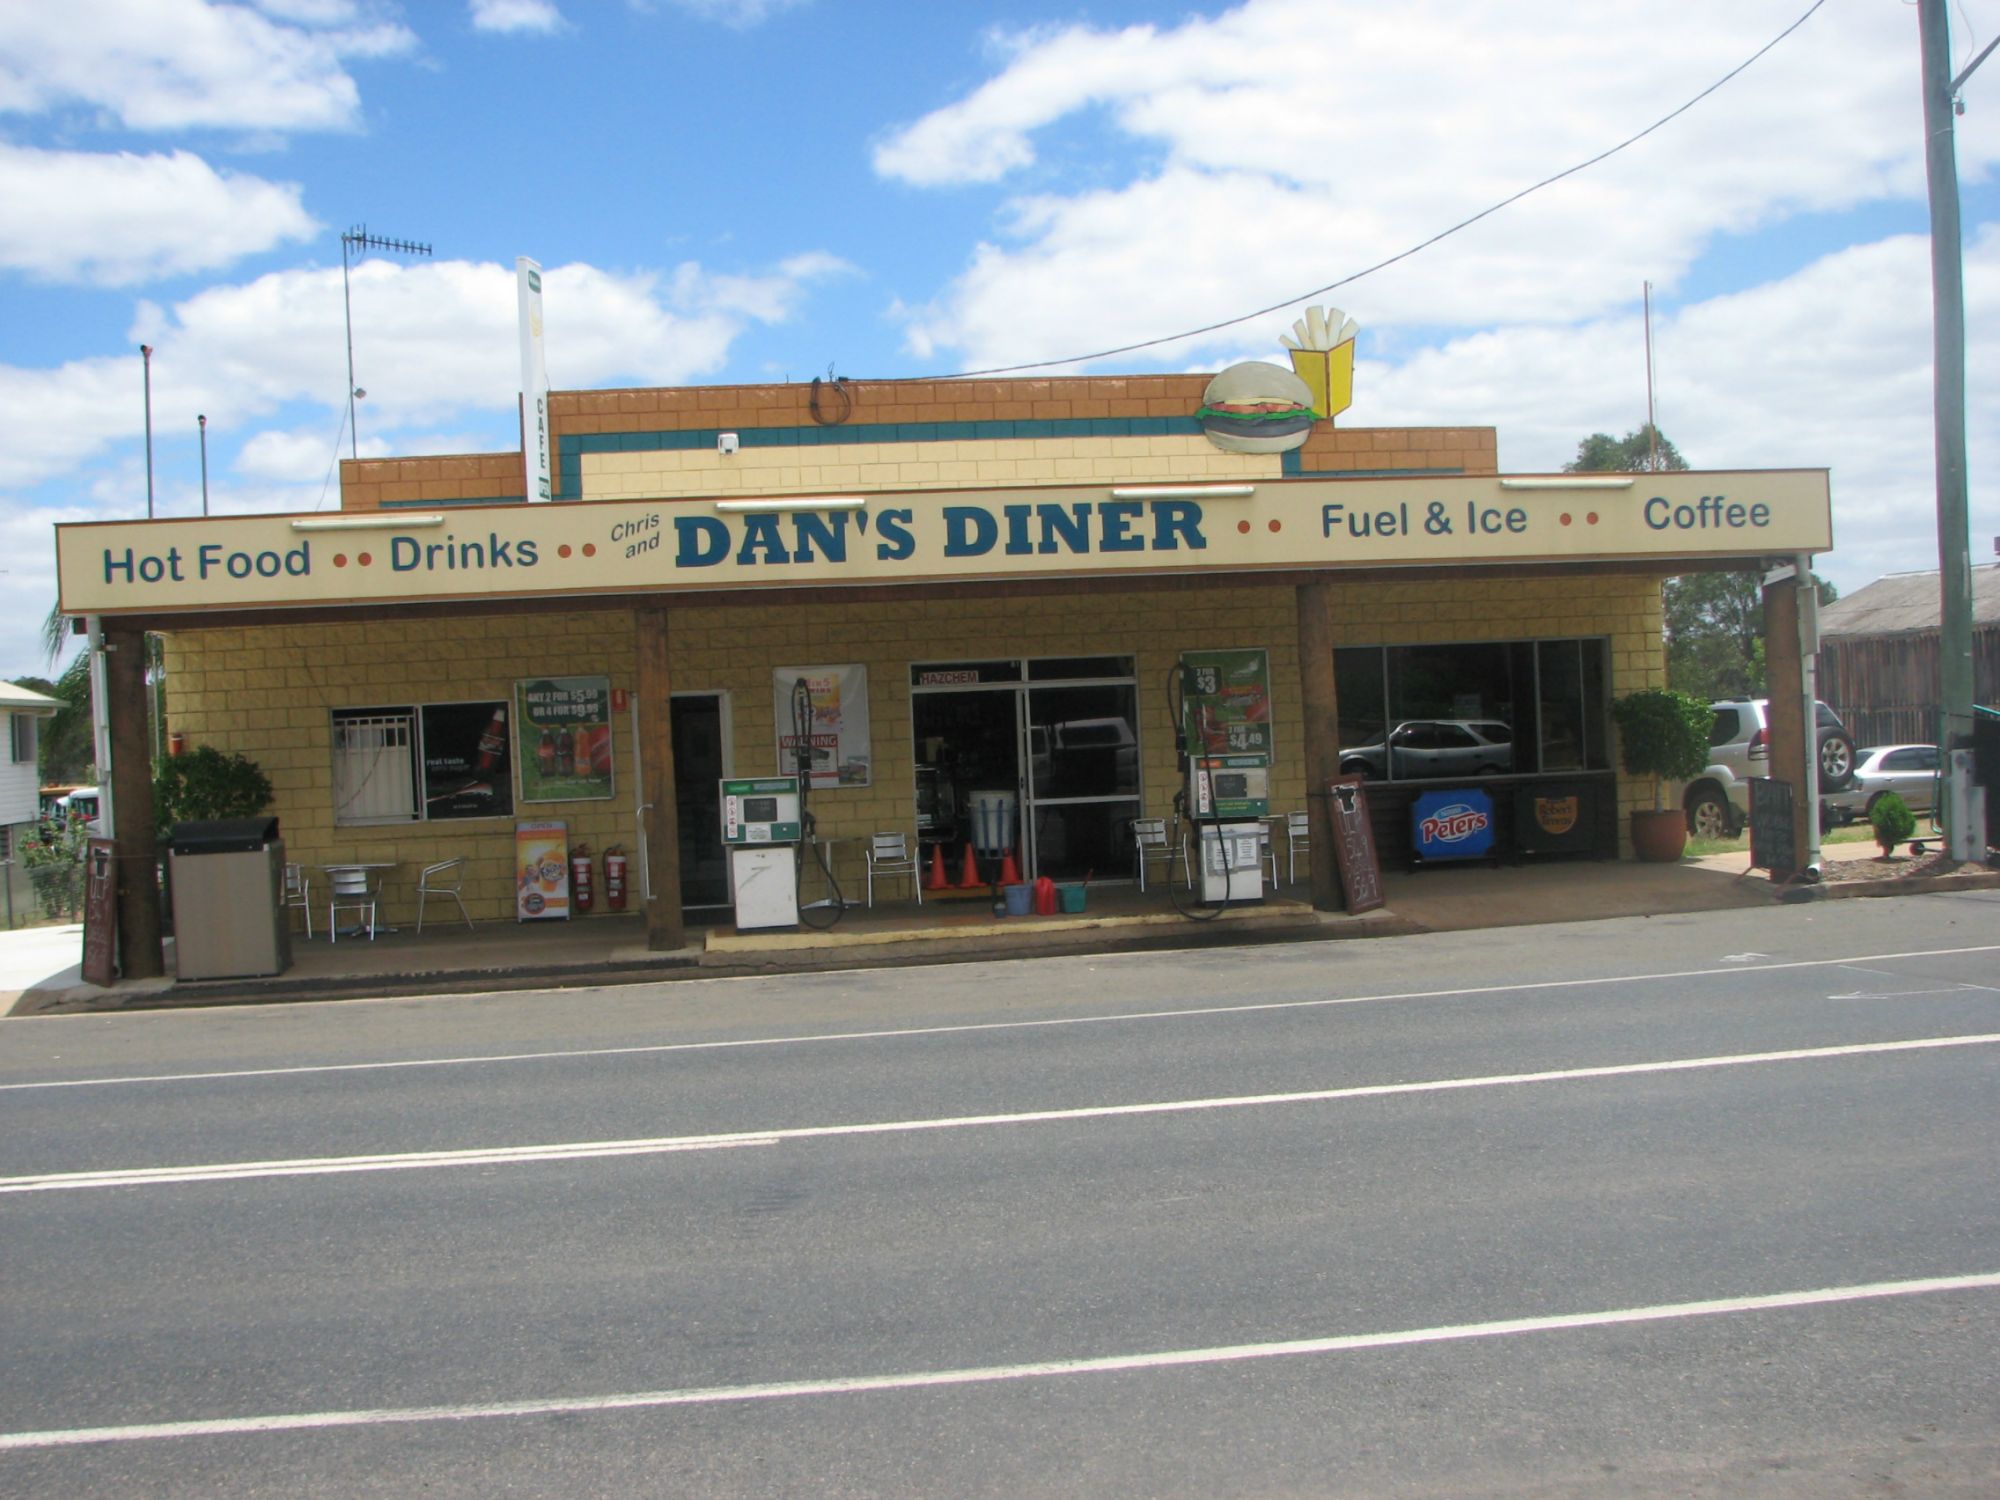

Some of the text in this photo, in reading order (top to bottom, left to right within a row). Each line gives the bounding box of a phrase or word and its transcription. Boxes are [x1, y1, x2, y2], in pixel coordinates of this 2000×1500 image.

[536, 398, 546, 469] CAFE
[610, 512, 660, 543] Chris
[1321, 500, 1528, 538] Fuel & Ice
[1643, 495, 1771, 531] Coffee
[624, 534, 660, 560] and
[674, 500, 1208, 568] DAN'S DINER
[103, 540, 312, 585] Hot Food
[390, 532, 540, 572] Drinks
[921, 671, 977, 685] HAZCHEM
[1197, 675, 1217, 694] $3
[545, 691, 551, 702] 2
[553, 690, 569, 701] FOR
[553, 705, 569, 717] FOR
[1229, 732, 1263, 750] $4.49
[1420, 812, 1488, 844] Peters
